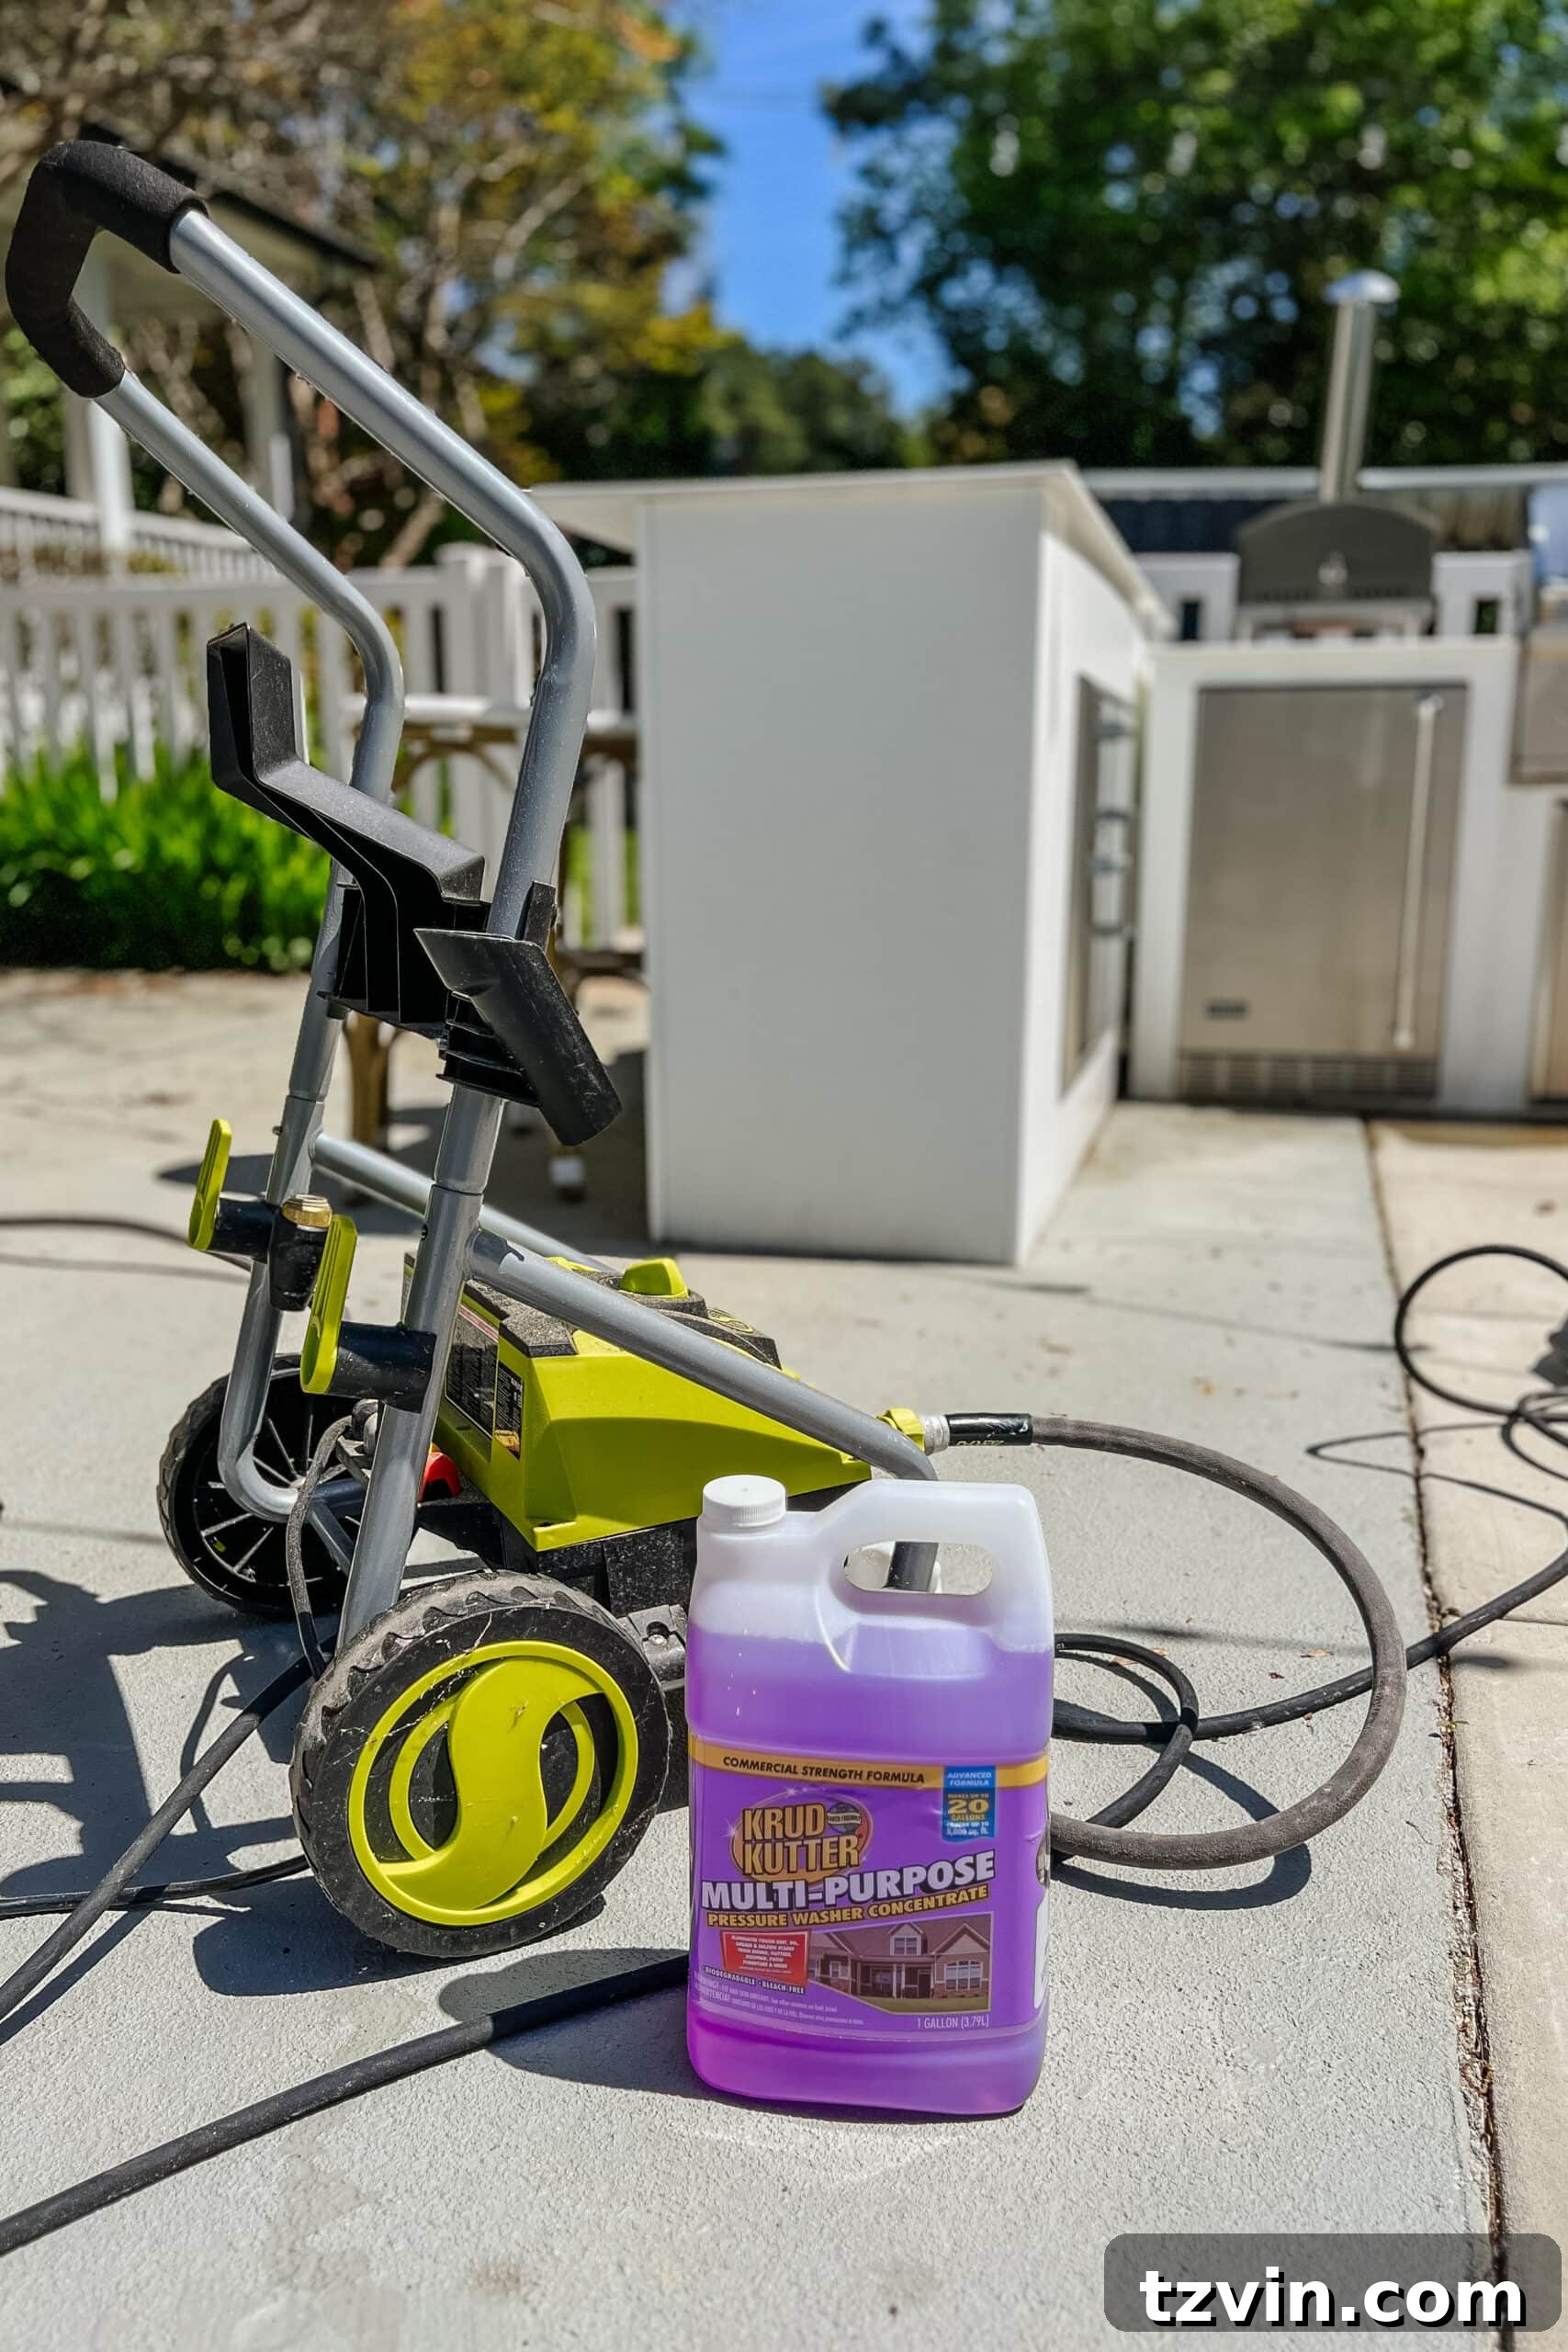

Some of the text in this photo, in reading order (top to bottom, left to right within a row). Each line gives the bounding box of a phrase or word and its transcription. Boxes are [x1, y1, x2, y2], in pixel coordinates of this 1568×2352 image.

[722, 1756, 926, 1784] COMMERCIAL STRENGTH FORMULA
[947, 1771, 992, 1780] ADVANCED
[947, 1799, 989, 1815] 20
[743, 1803, 826, 1840] KRUD
[743, 1834, 860, 1875] KUTTER
[701, 1849, 996, 1910] MULTI-PURPOSE
[707, 1884, 989, 1928] PRESSURE WASHER CONCENTRATE
[705, 1965, 755, 1985] BIODEGRADABLE
[917, 2013, 989, 2030] 1 GALLON (3.79L)
